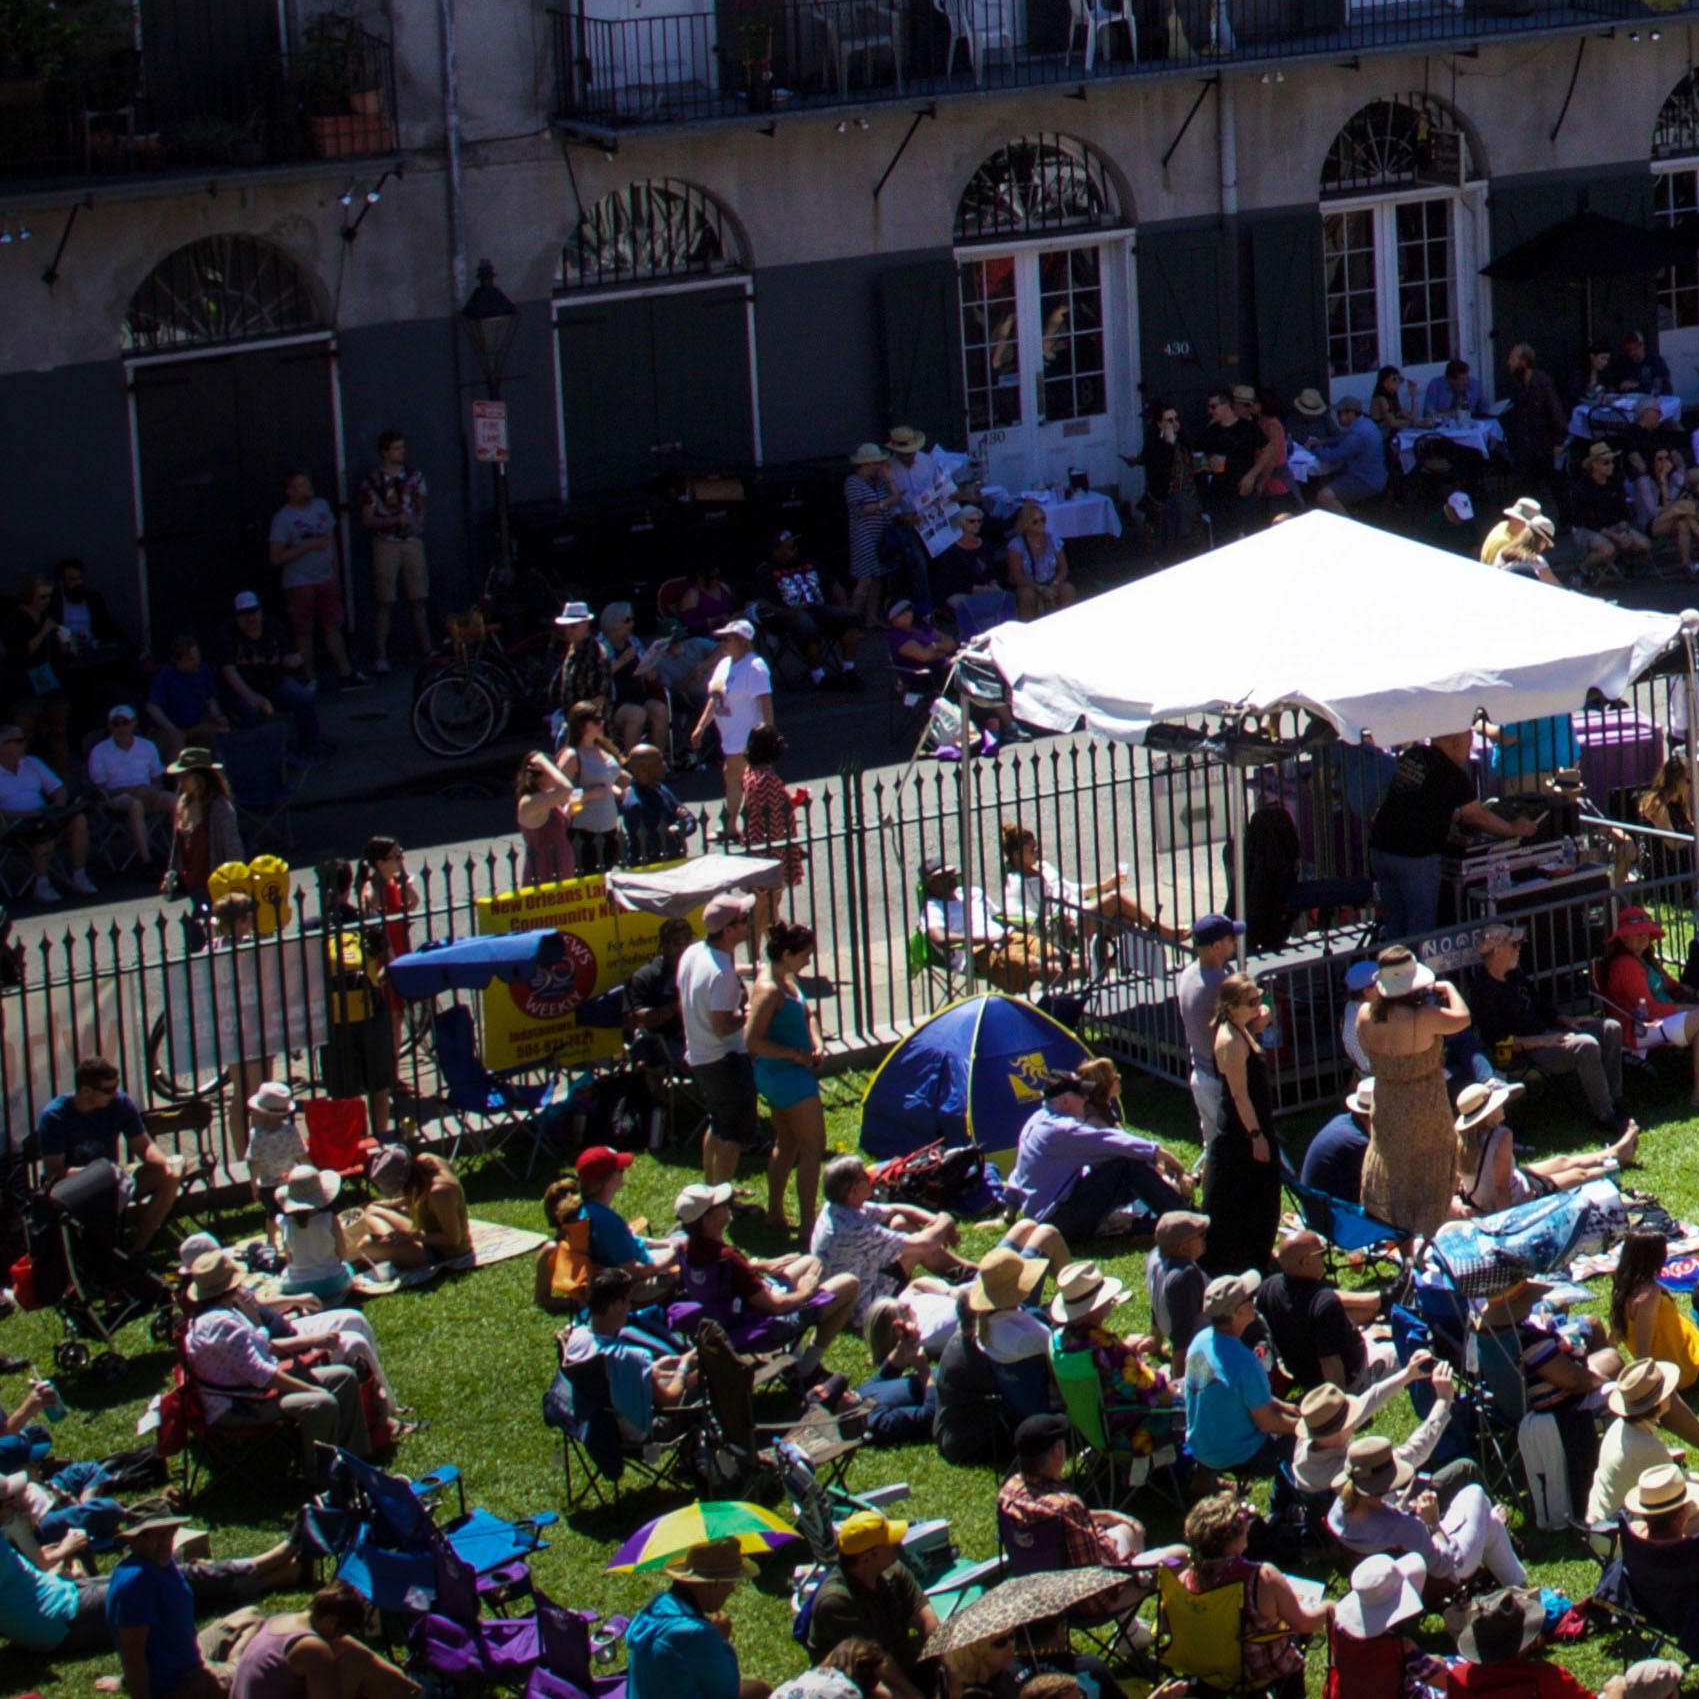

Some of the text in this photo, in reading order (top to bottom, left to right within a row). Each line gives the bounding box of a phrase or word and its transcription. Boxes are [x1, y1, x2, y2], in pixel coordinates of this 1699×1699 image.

[1164, 343, 1191, 357] 430
[981, 432, 1007, 445] 430
[490, 899, 522, 916] New
[525, 887, 584, 911] Orleans
[510, 907, 597, 930] Community
[562, 935, 594, 966] EWS
[629, 934, 658, 947] Adver
[526, 990, 584, 1017] WEEKLY
